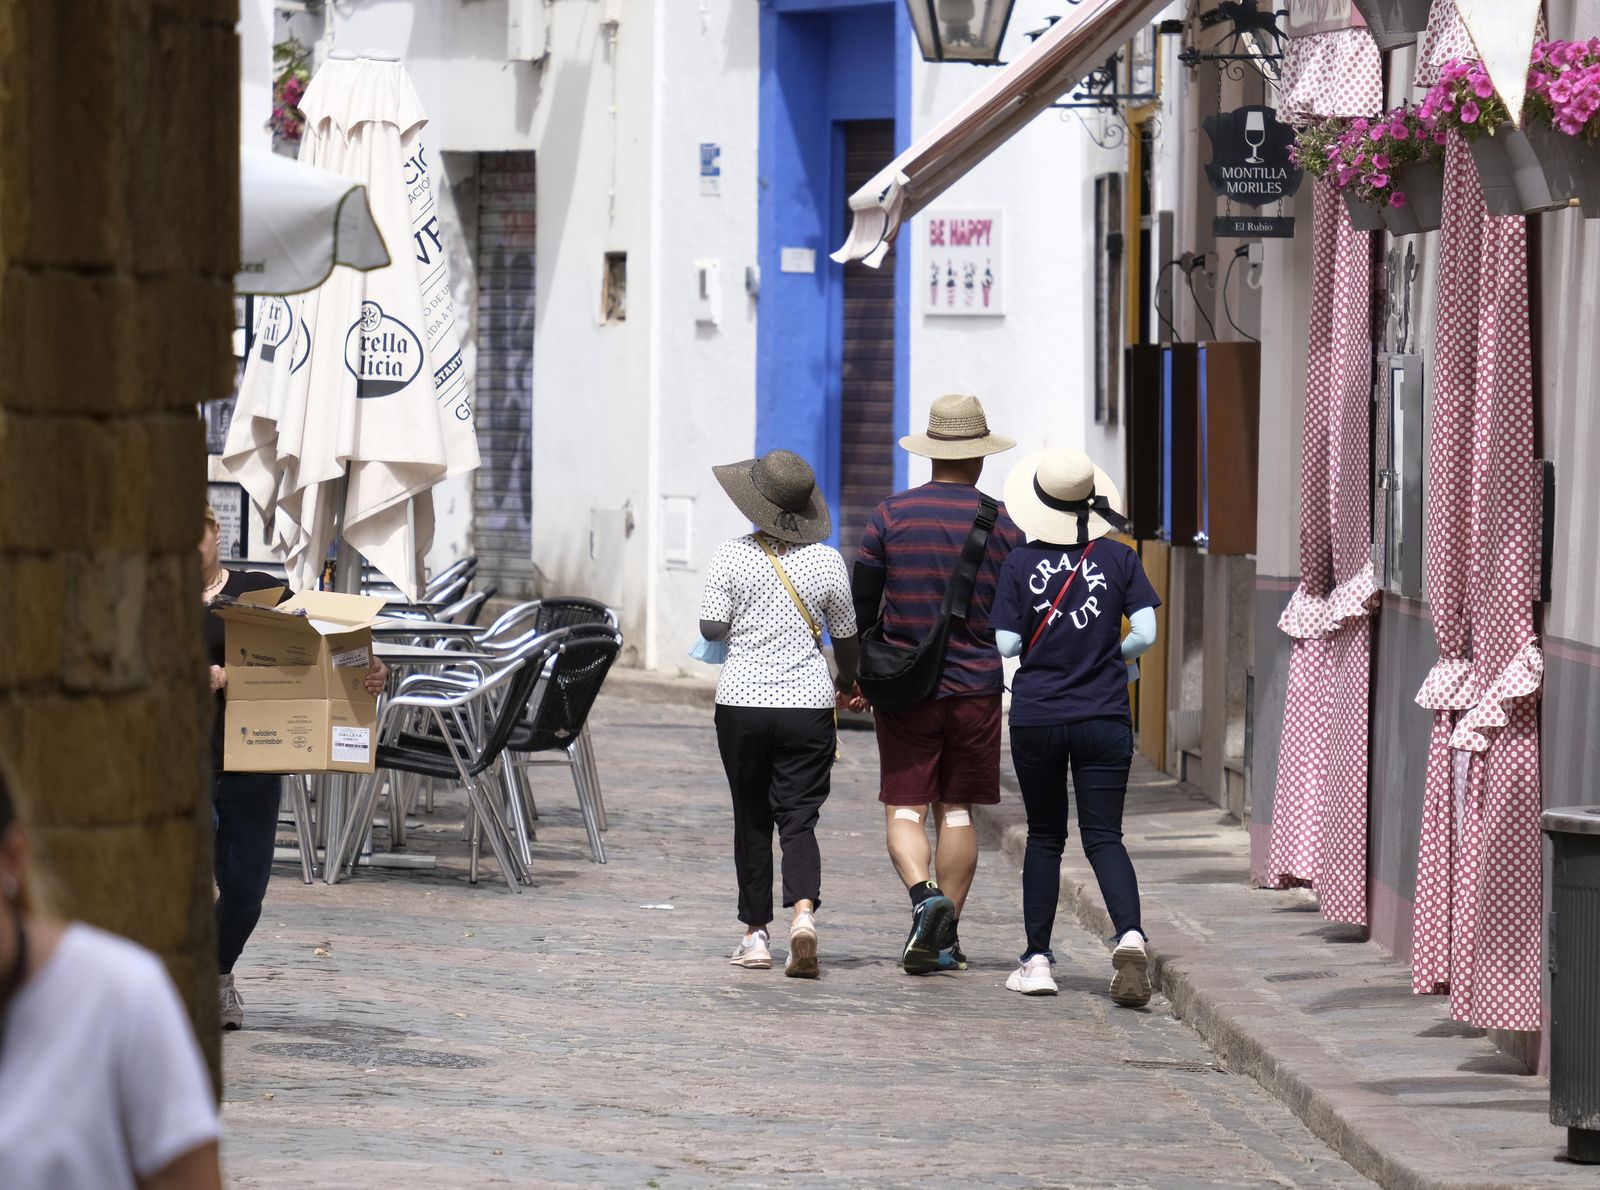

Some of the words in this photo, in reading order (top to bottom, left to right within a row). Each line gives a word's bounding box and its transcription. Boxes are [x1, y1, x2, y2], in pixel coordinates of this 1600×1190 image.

[1221, 166, 1288, 180] MONTILLA
[408, 177, 431, 205] ACIÓ
[1226, 181, 1282, 194] MORILES
[930, 219, 945, 247] BE
[949, 219, 993, 247] HAPPY
[1235, 222, 1245, 231] El
[1247, 222, 1273, 232] Rubio
[430, 293, 443, 308] DE
[427, 319, 443, 340] IDA
[359, 332, 408, 354] rella
[359, 354, 403, 377] licia
[434, 354, 462, 387] STANT
[1029, 552, 1108, 595] CRANK
[1033, 599, 1064, 626] IT
[1069, 595, 1102, 630] UP
